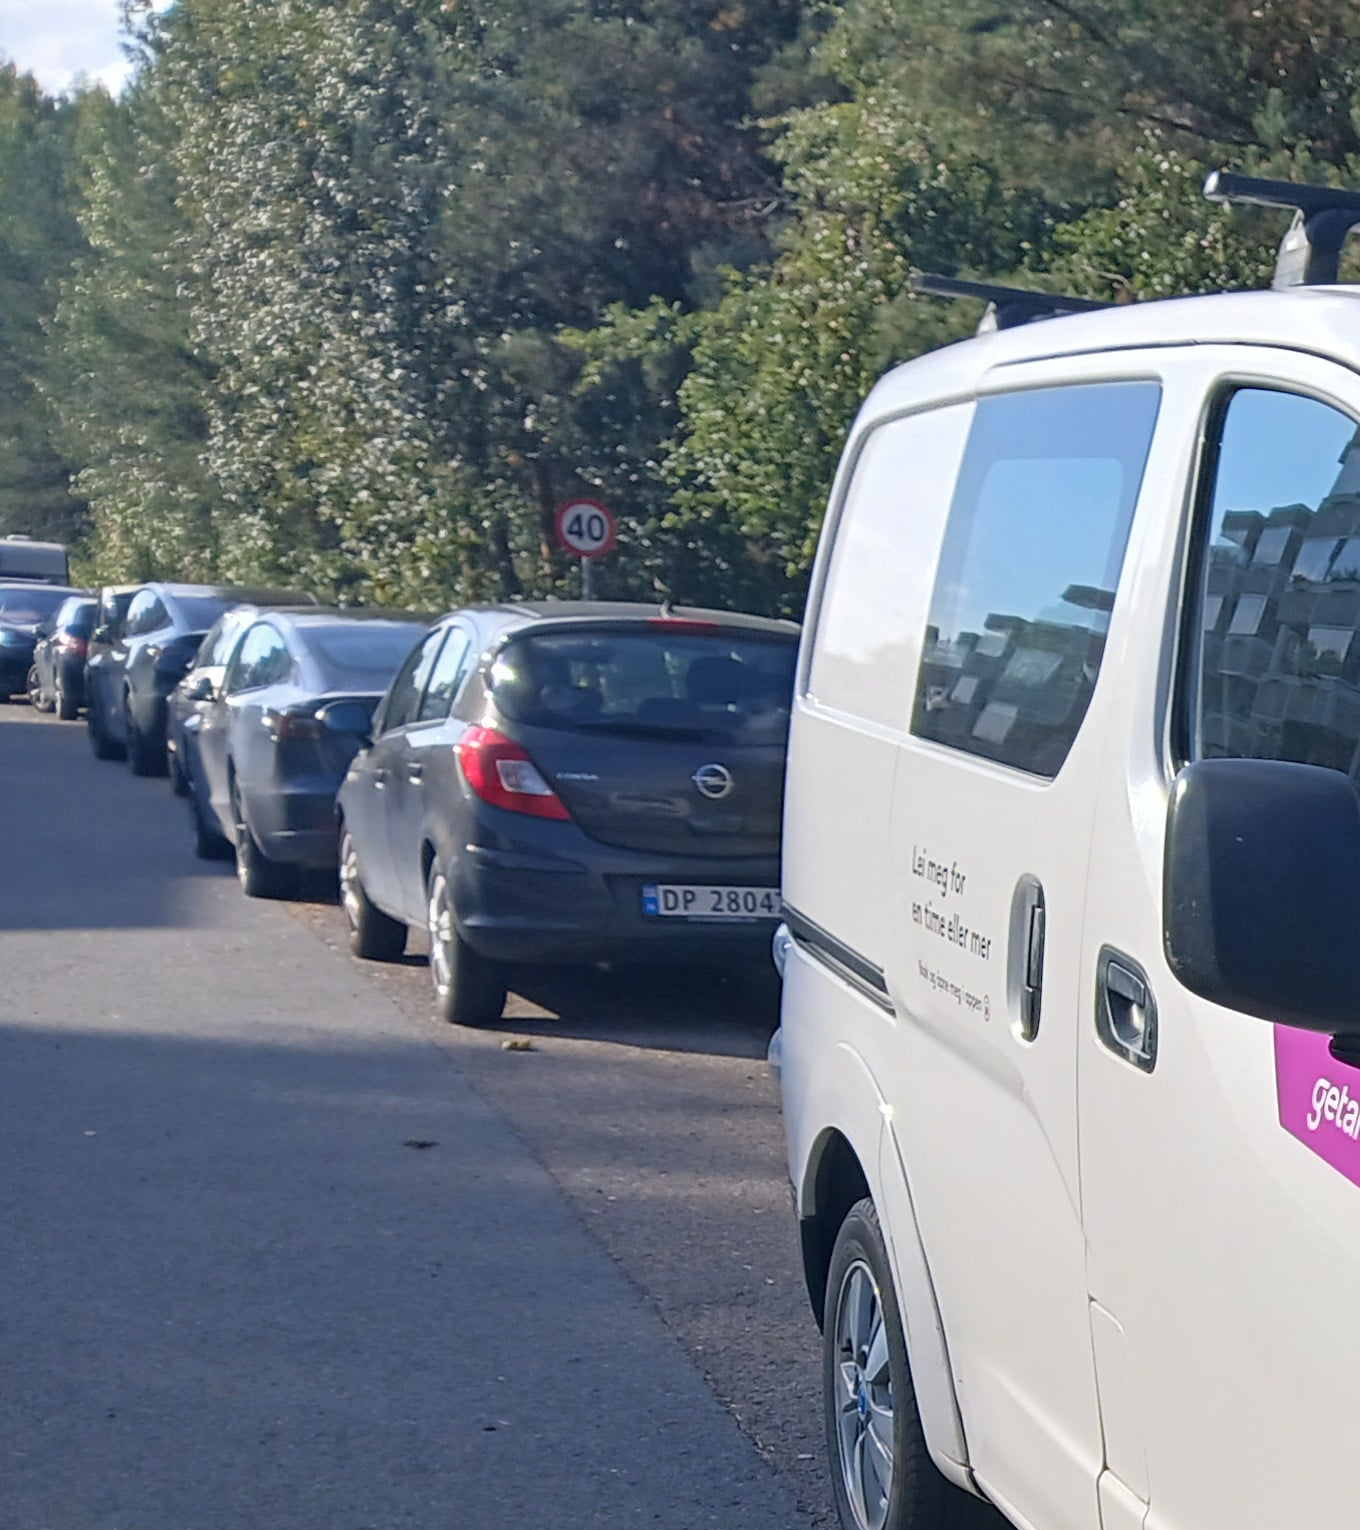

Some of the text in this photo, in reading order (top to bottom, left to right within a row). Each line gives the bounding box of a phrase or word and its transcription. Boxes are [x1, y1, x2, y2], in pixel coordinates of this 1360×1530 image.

[567, 513, 605, 542] 40
[911, 844, 967, 898] Lei meg for
[662, 888, 697, 912] DP
[911, 900, 992, 961] en time eller mer
